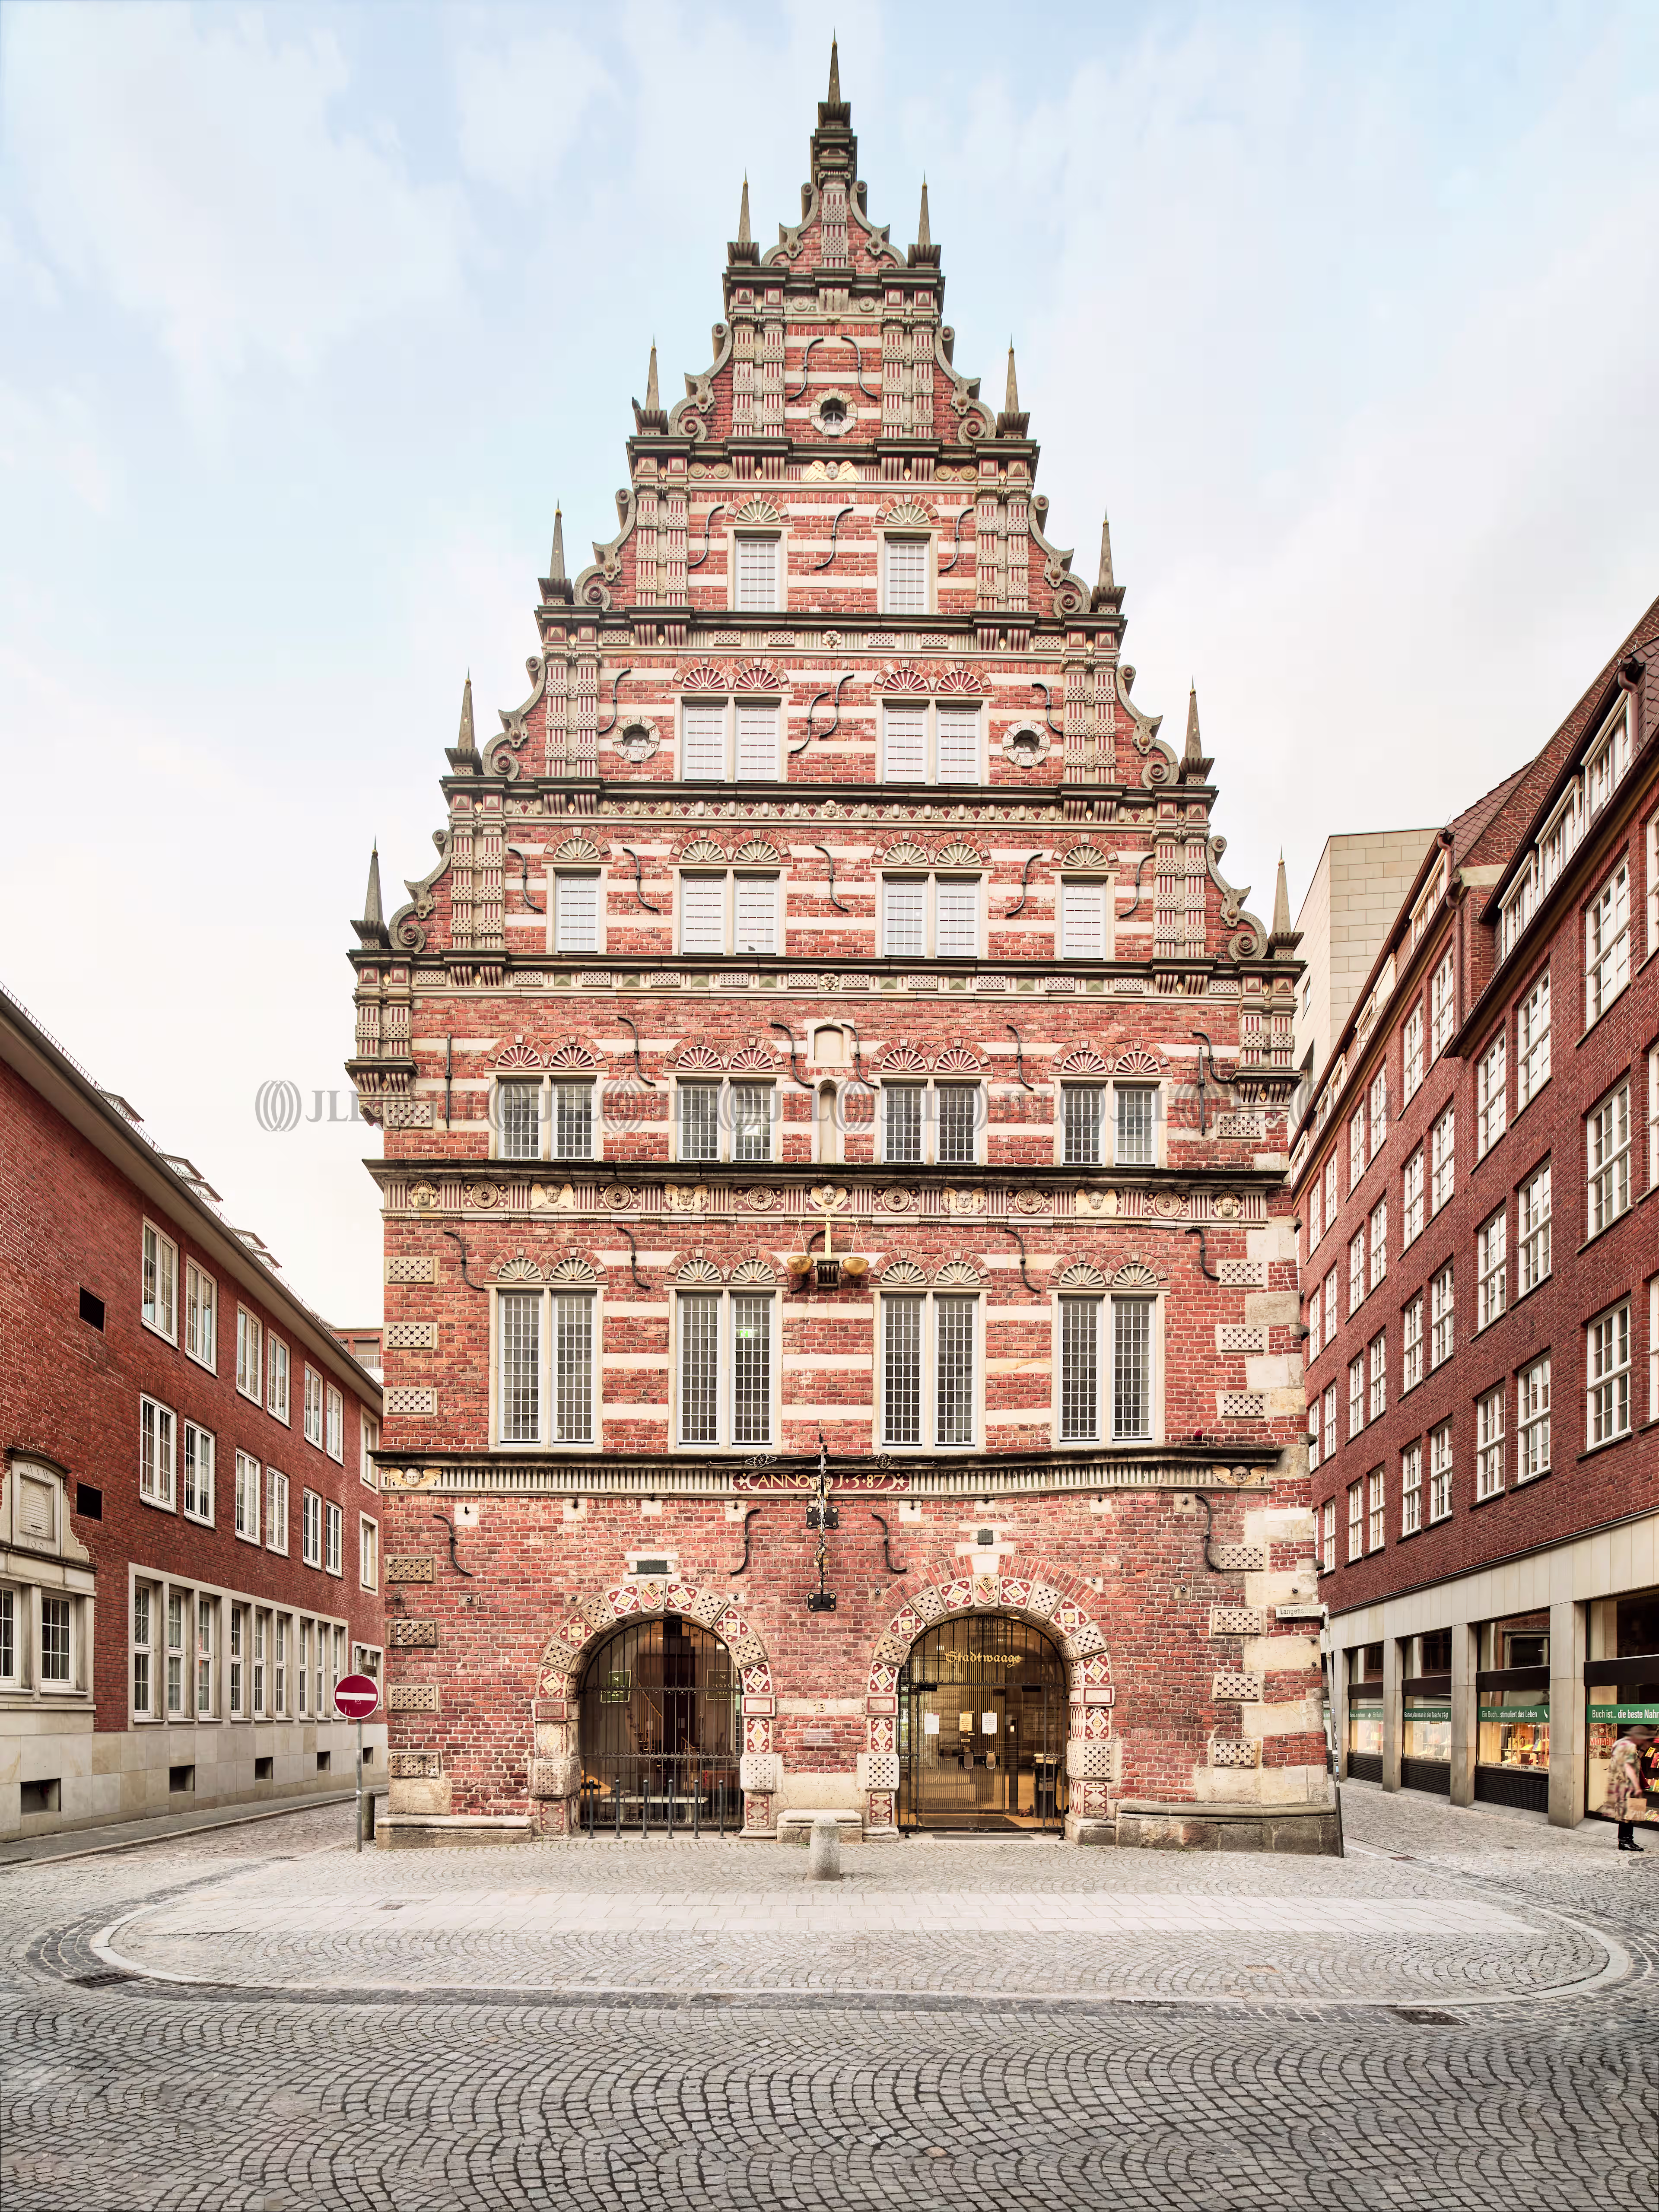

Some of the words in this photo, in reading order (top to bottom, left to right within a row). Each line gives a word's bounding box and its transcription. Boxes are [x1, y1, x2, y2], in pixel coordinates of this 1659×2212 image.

[756, 1474, 810, 1488] ANNO
[1280, 1608, 1319, 1616] Langens
[945, 1649, 1020, 1668] Stadtwaage
[1592, 1709, 1605, 1718] Buch
[1618, 1710, 1626, 1718] die
[1627, 1710, 1643, 1718] beste
